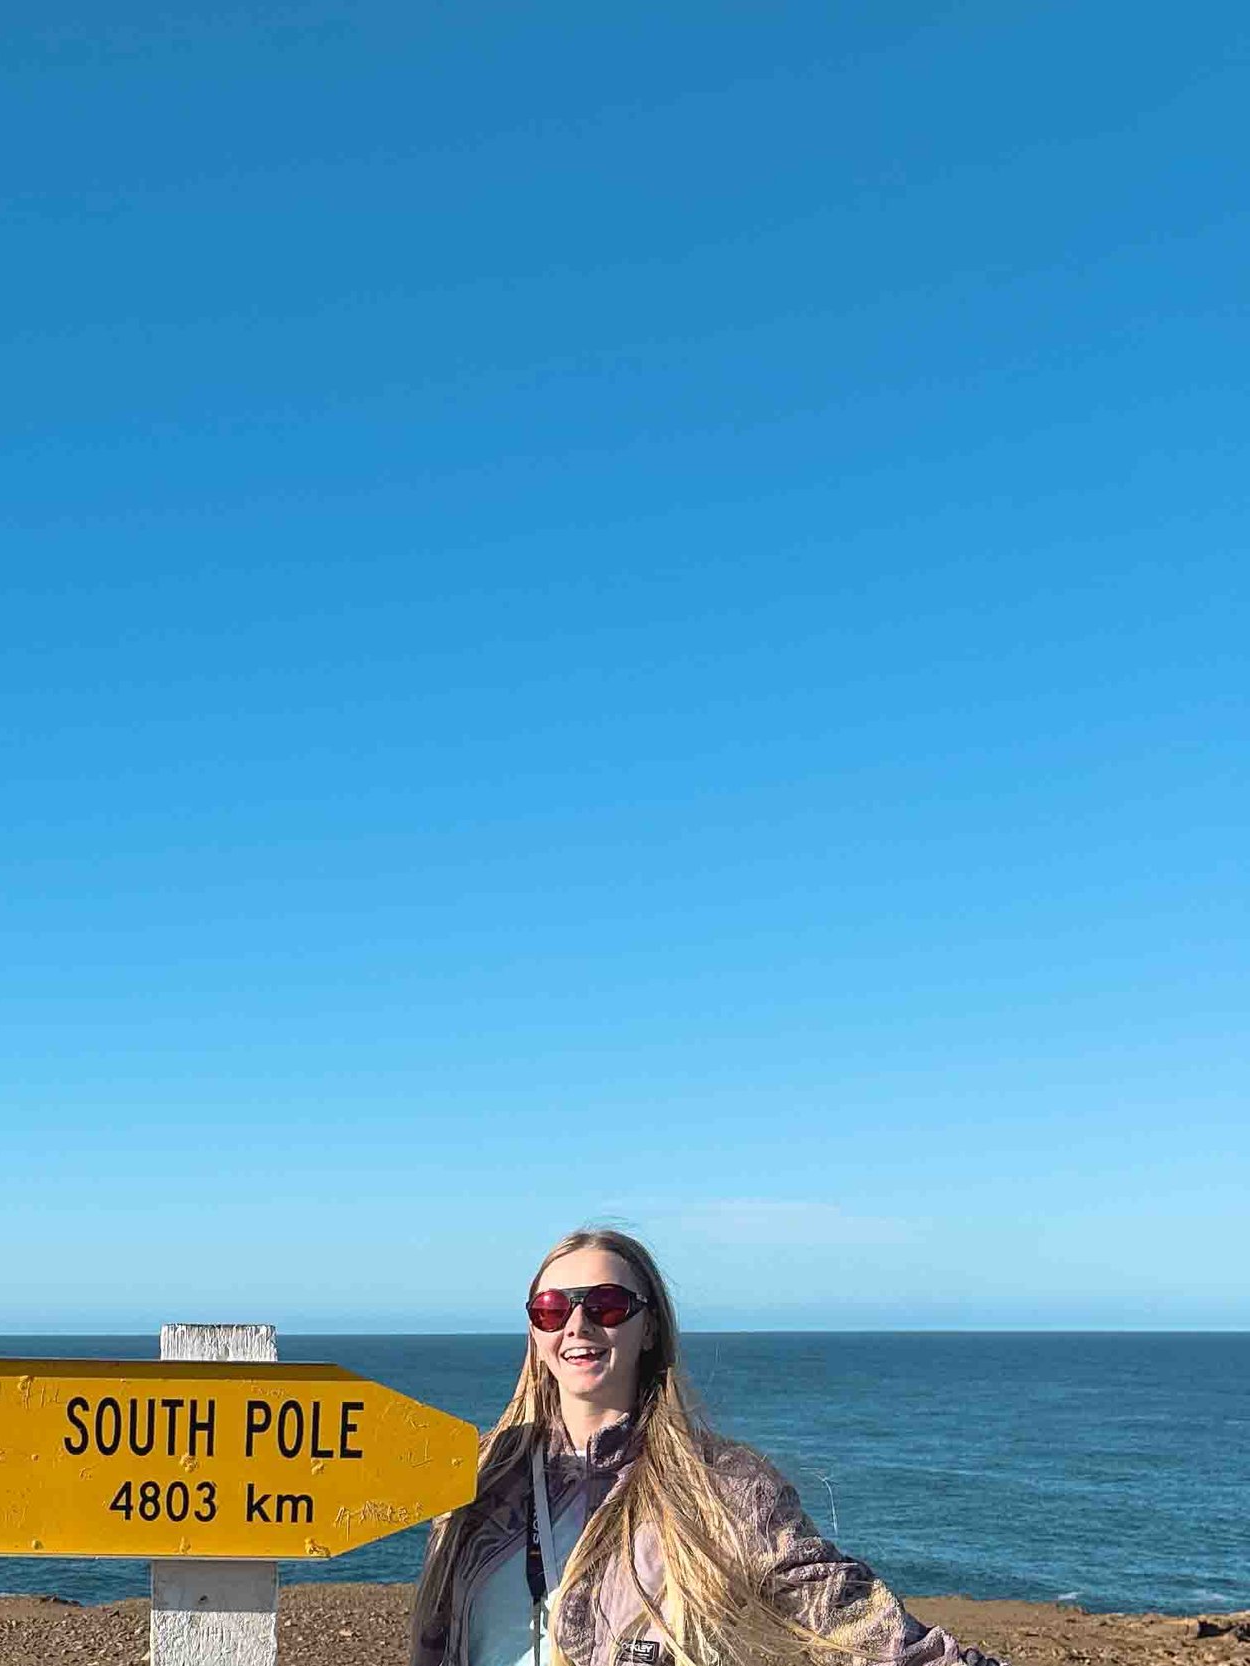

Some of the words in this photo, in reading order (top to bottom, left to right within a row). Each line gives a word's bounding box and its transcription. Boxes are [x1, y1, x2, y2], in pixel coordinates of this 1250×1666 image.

[63, 1396, 216, 1457] SOUTH
[245, 1400, 365, 1460] POLE
[109, 1481, 218, 1523] 4803
[246, 1483, 314, 1523] km
